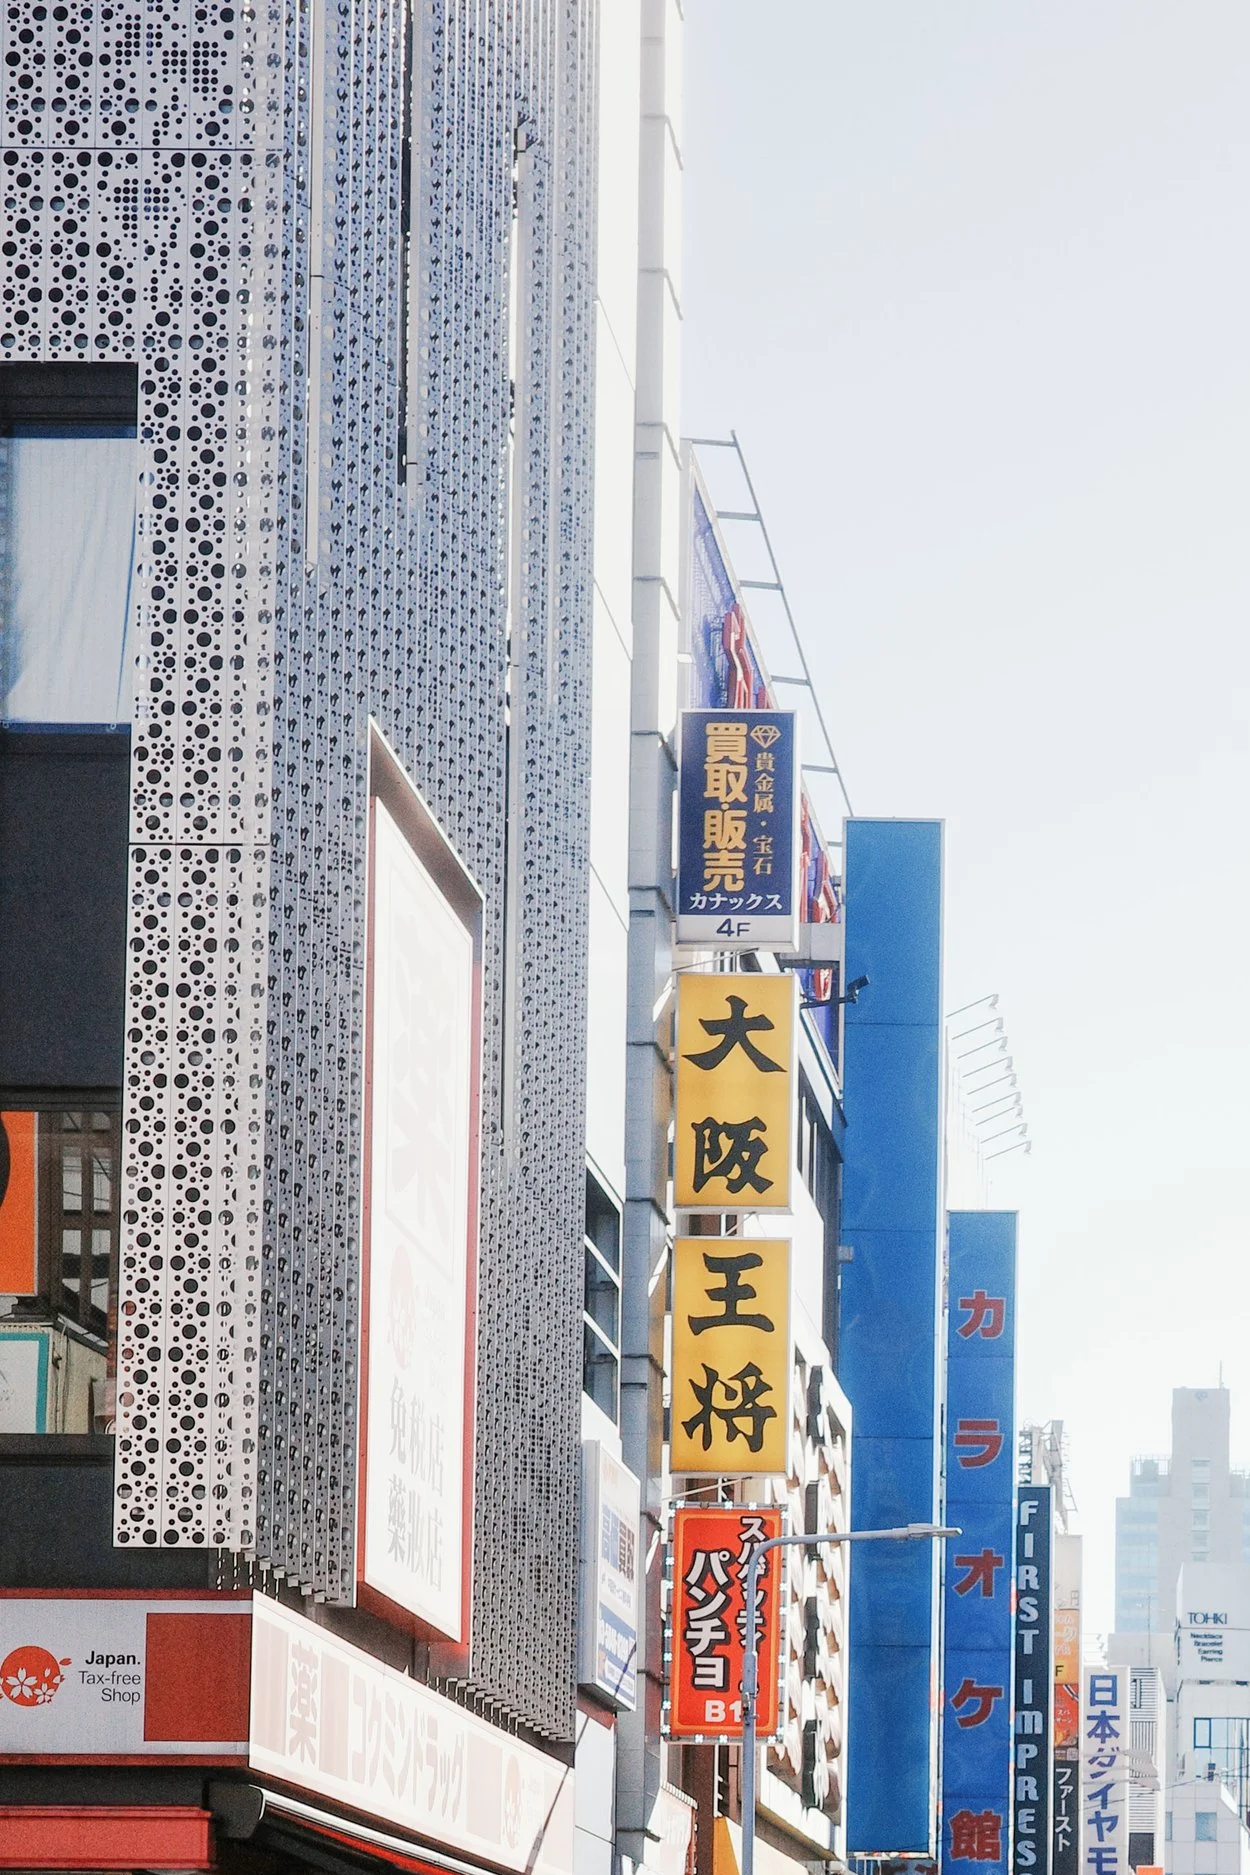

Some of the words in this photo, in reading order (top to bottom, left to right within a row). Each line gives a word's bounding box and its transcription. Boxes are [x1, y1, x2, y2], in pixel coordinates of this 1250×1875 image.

[702, 722, 749, 892] 買取・販売
[752, 752, 775, 876] 貴金属・宝石
[689, 892, 783, 911] カナックス
[716, 921, 750, 938] 4F
[682, 994, 788, 1194] 大阪
[682, 1252, 777, 1452] 王将
[685, 1551, 730, 1688] パンチョ
[949, 1288, 1006, 1863] カラオケ館
[1018, 1500, 1041, 1656] FIRST
[1187, 1612, 1228, 1625] TOHKI
[78, 1670, 142, 1687] Tax-free
[86, 1650, 142, 1668] Japan.
[101, 1688, 142, 1706] Shop
[1054, 1767, 1074, 1852] ファースト
